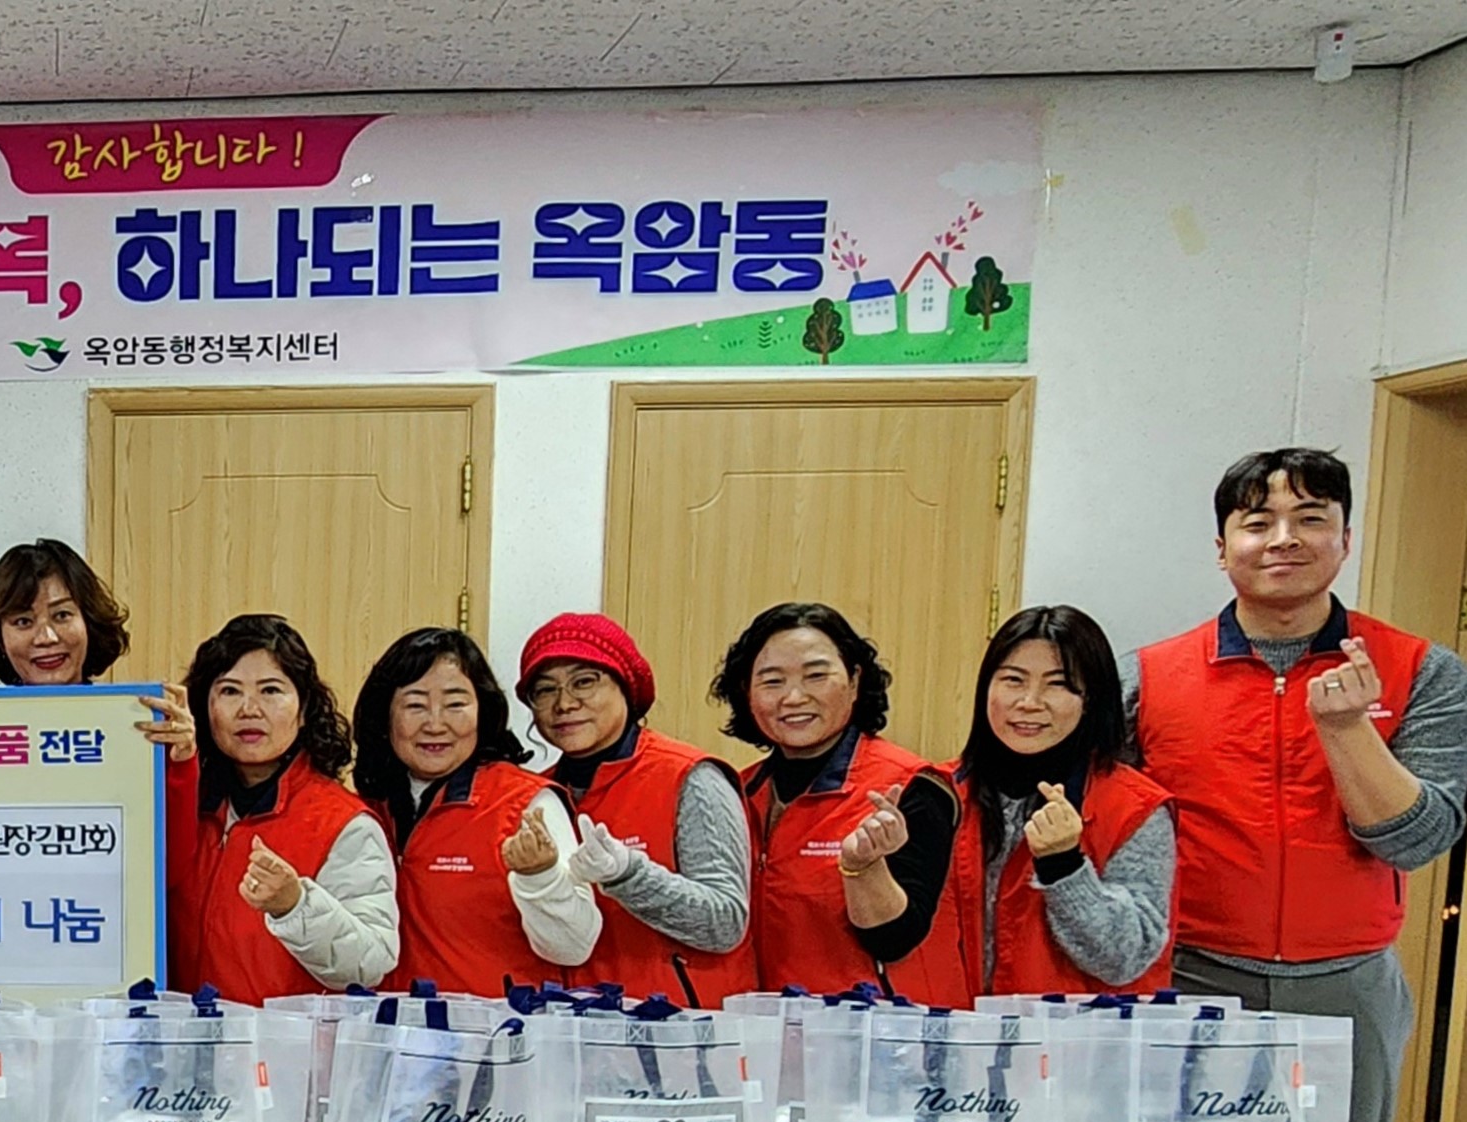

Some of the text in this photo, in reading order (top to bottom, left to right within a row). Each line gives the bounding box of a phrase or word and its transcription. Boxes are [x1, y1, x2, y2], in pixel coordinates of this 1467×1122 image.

[115, 204, 500, 302] 하나되는
[532, 200, 828, 293] 옥암동
[83, 332, 339, 367] 옥암동행정복지센터
[39, 729, 105, 763] 전달
[22, 898, 106, 943] 나눔
[133, 1086, 232, 1121] Nothing
